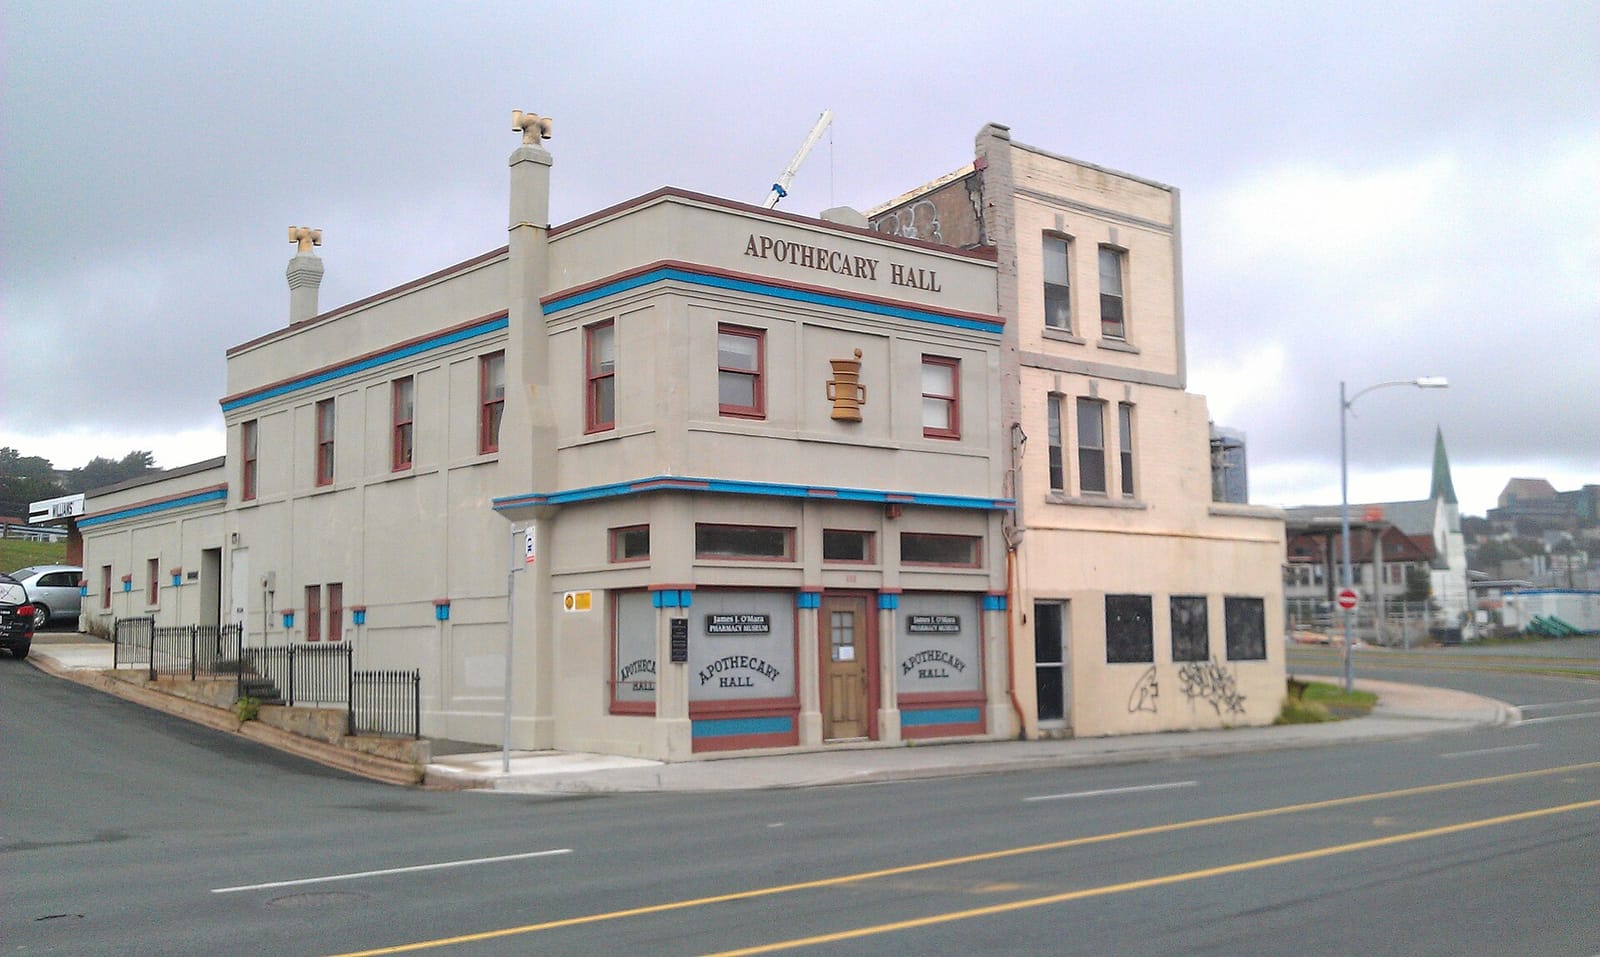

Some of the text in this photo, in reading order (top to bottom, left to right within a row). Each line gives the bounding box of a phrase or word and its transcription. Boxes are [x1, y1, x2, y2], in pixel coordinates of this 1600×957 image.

[744, 234, 942, 292] APOTHECARY HALL
[709, 624, 768, 632] PHARMACY MUSEUM
[713, 615, 734, 624] James
[741, 615, 764, 623] O'Mara
[621, 659, 656, 682] APOTHECA
[699, 656, 780, 685] APOTHECARY
[902, 650, 966, 676] APOTHECARY
[719, 676, 754, 688] HALL
[918, 669, 949, 679] HALL
